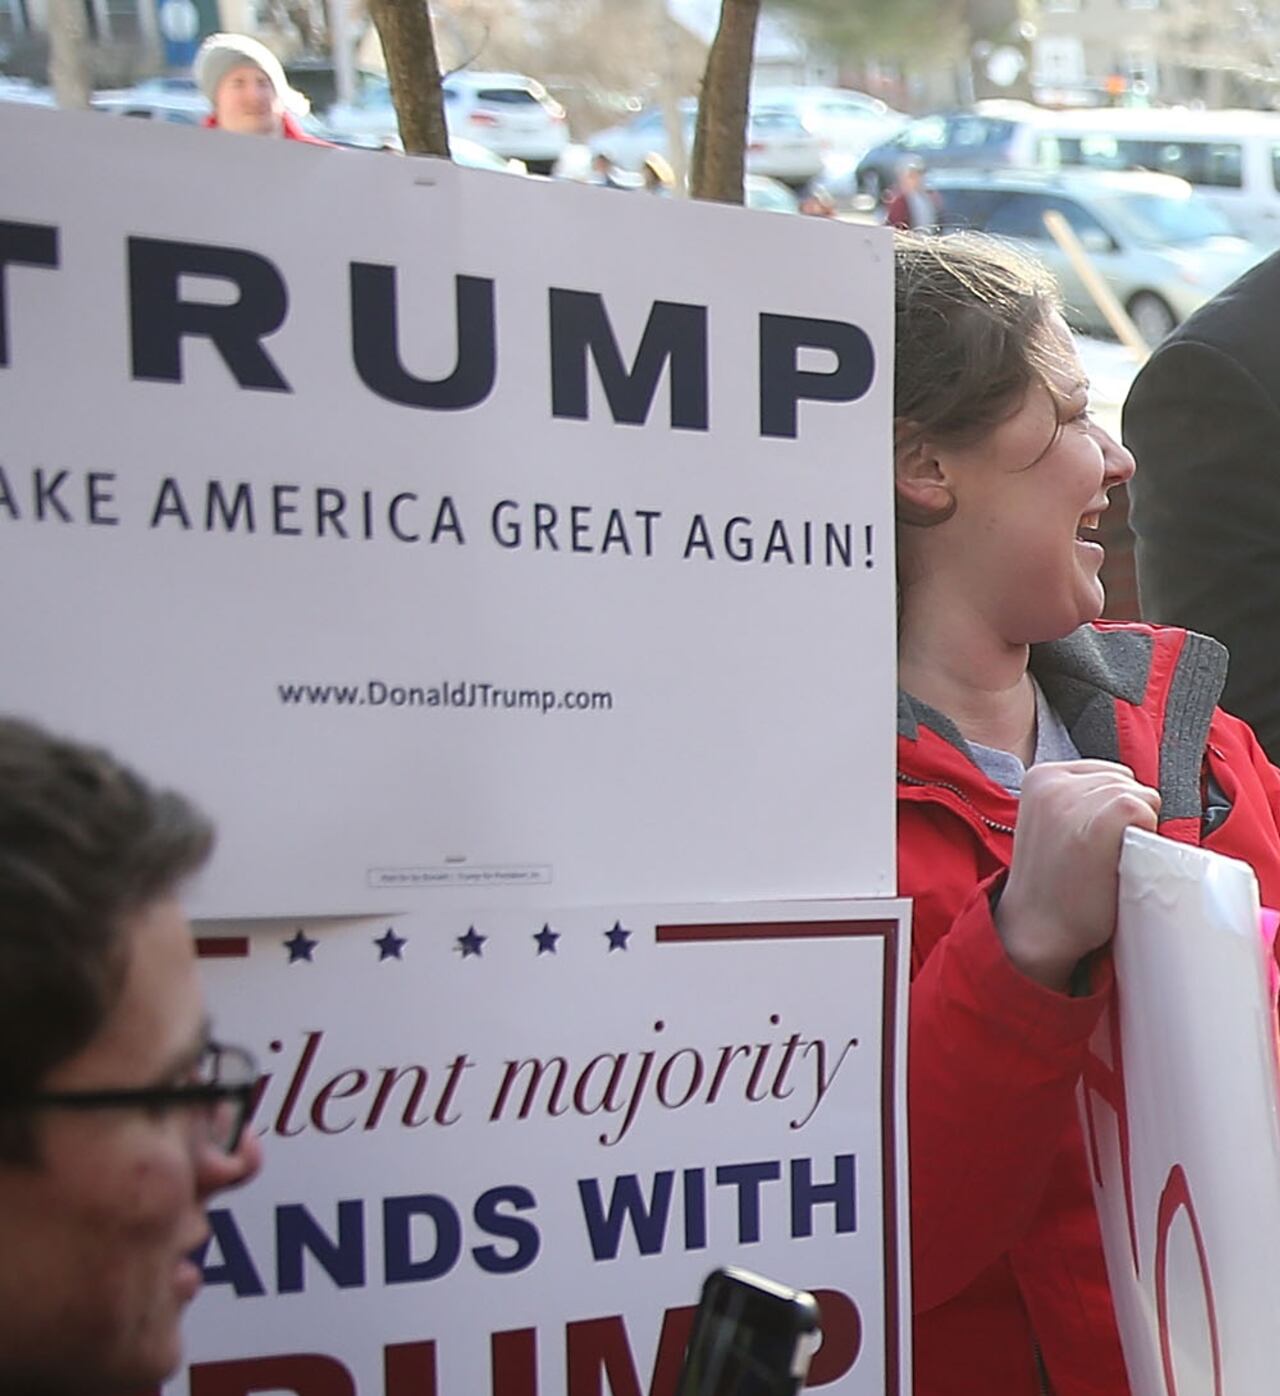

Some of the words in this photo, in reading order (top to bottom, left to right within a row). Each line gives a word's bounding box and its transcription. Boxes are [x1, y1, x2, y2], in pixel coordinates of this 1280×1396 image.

[0, 466, 119, 526] KE
[150, 477, 466, 546] AMERICA
[491, 499, 662, 557] GREAT
[684, 513, 876, 569] AGAIN!
[277, 680, 614, 714] www.DonaldJTrump.com
[249, 1030, 476, 1139] ilent
[488, 1013, 861, 1147] majority
[184, 1184, 543, 1299] ANDS
[577, 1153, 859, 1262] WITH
